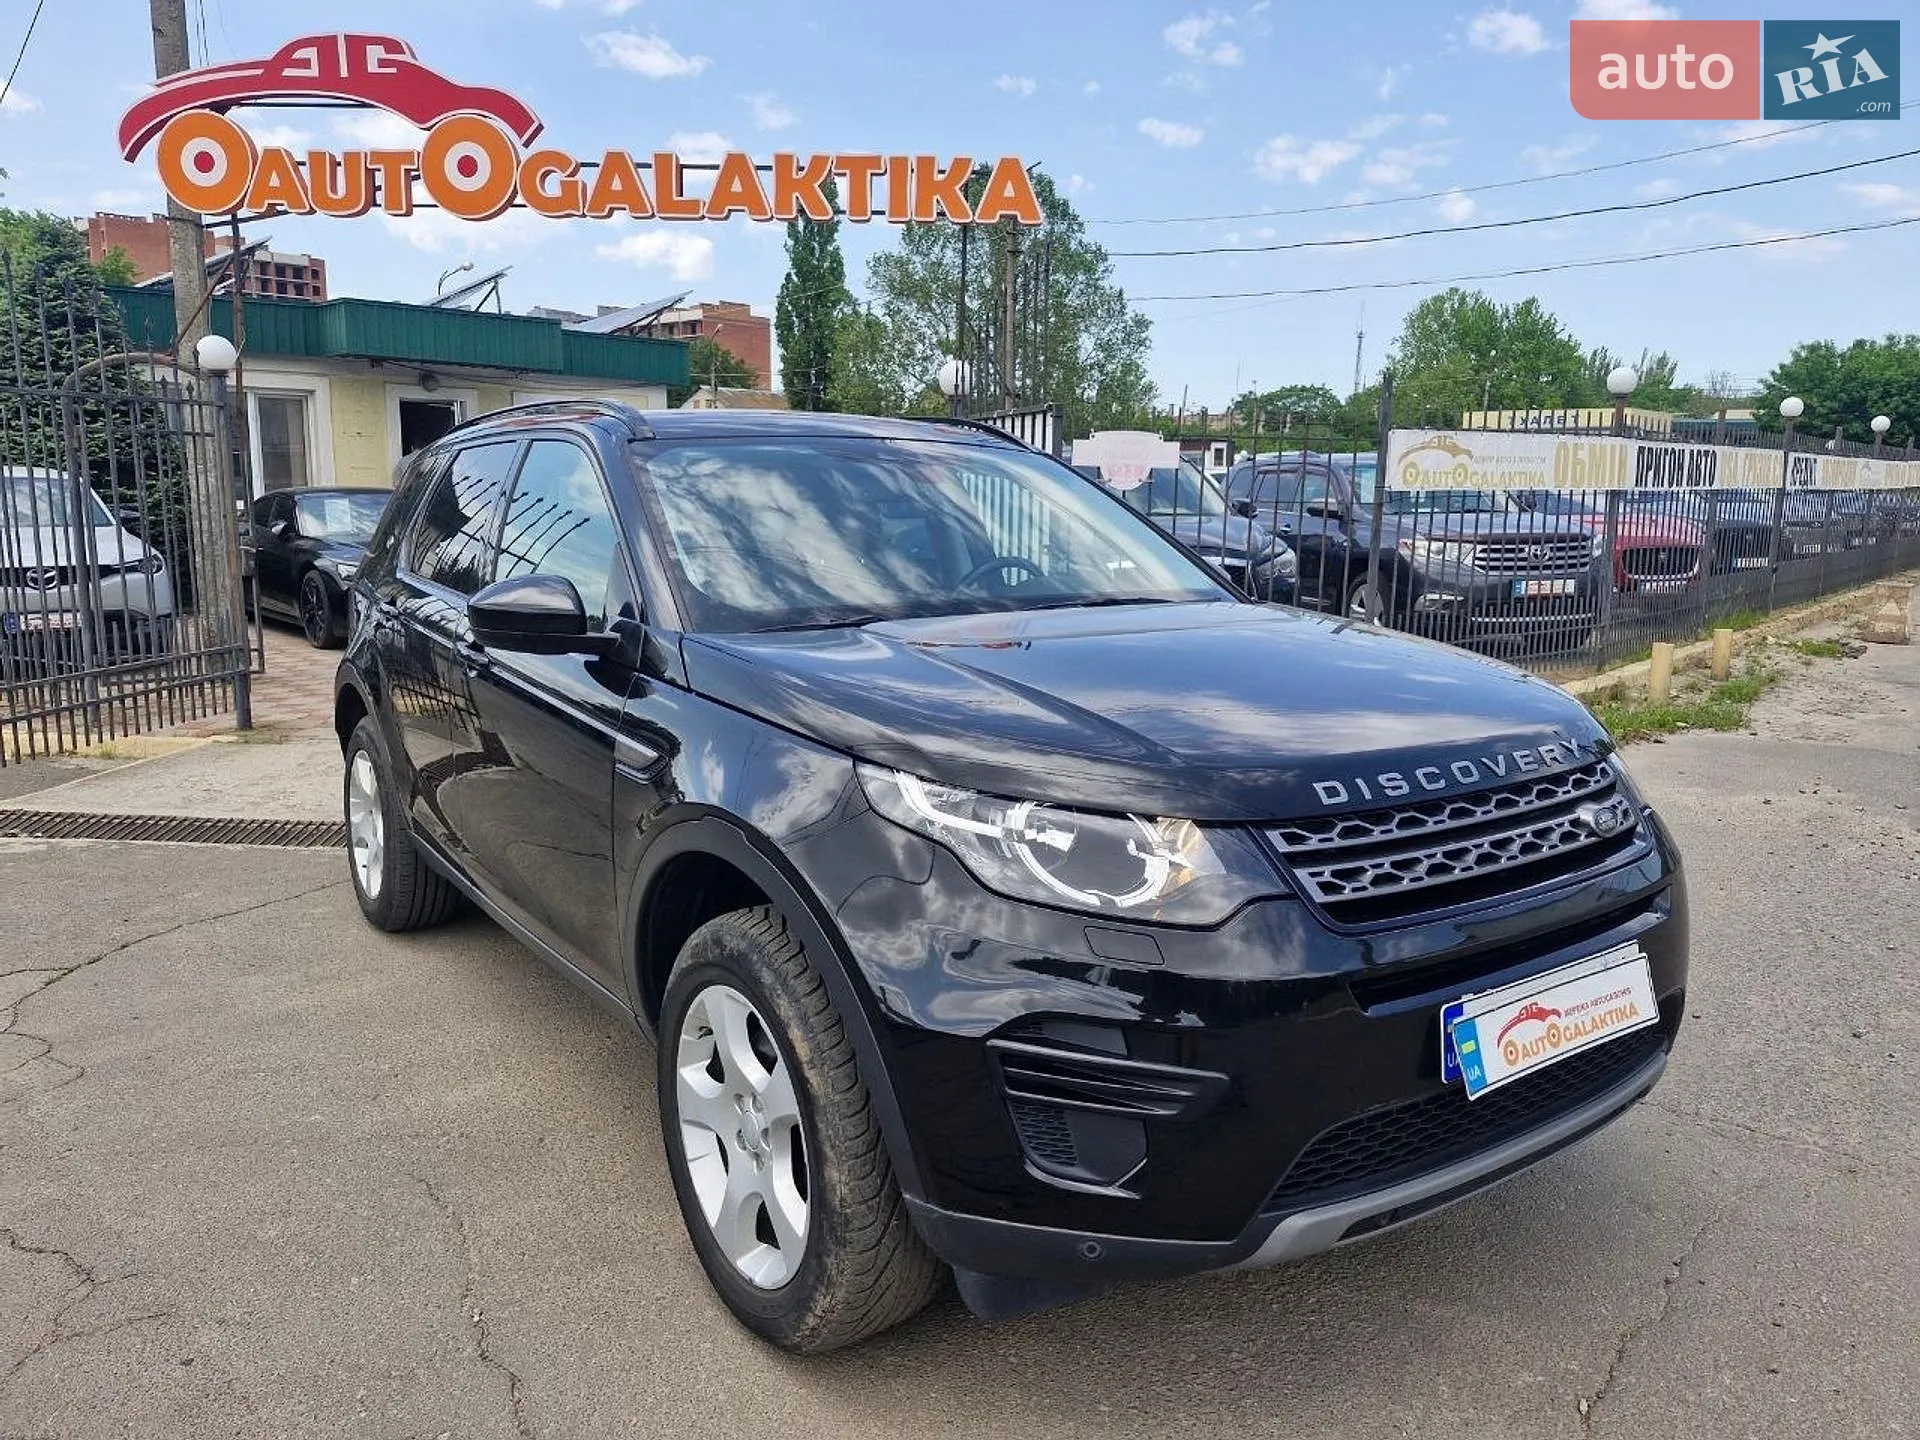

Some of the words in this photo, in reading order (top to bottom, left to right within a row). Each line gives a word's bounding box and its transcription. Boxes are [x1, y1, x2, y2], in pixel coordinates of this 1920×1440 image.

[1554, 441, 1629, 488] ОБМІН
[1634, 445, 1686, 488] ПРИГОН
[1686, 449, 1717, 488] АВТО
[1312, 738, 1584, 806] DISCOVERY
[1466, 1063, 1482, 1081] UA
